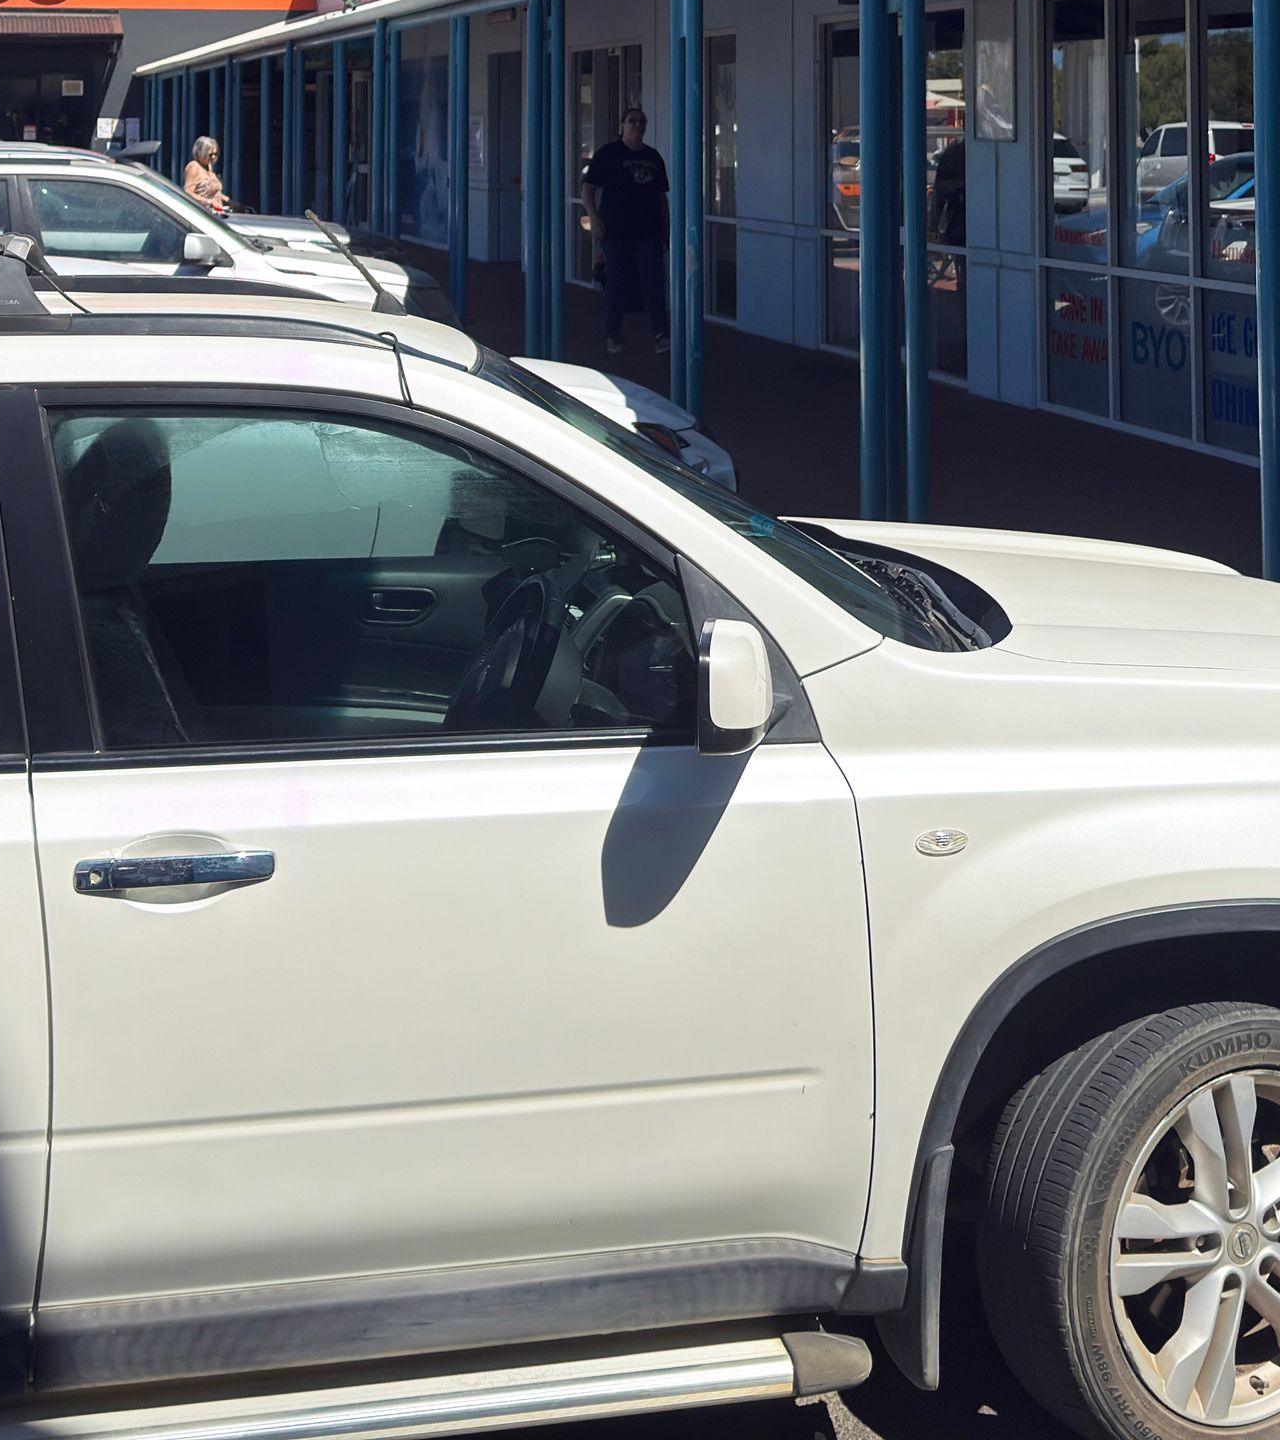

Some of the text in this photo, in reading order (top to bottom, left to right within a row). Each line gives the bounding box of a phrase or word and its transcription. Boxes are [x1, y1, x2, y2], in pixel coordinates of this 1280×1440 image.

[1082, 336, 1108, 365] AWA
[1131, 320, 1187, 371] BYO
[1179, 1031, 1272, 1078] KUMHO
